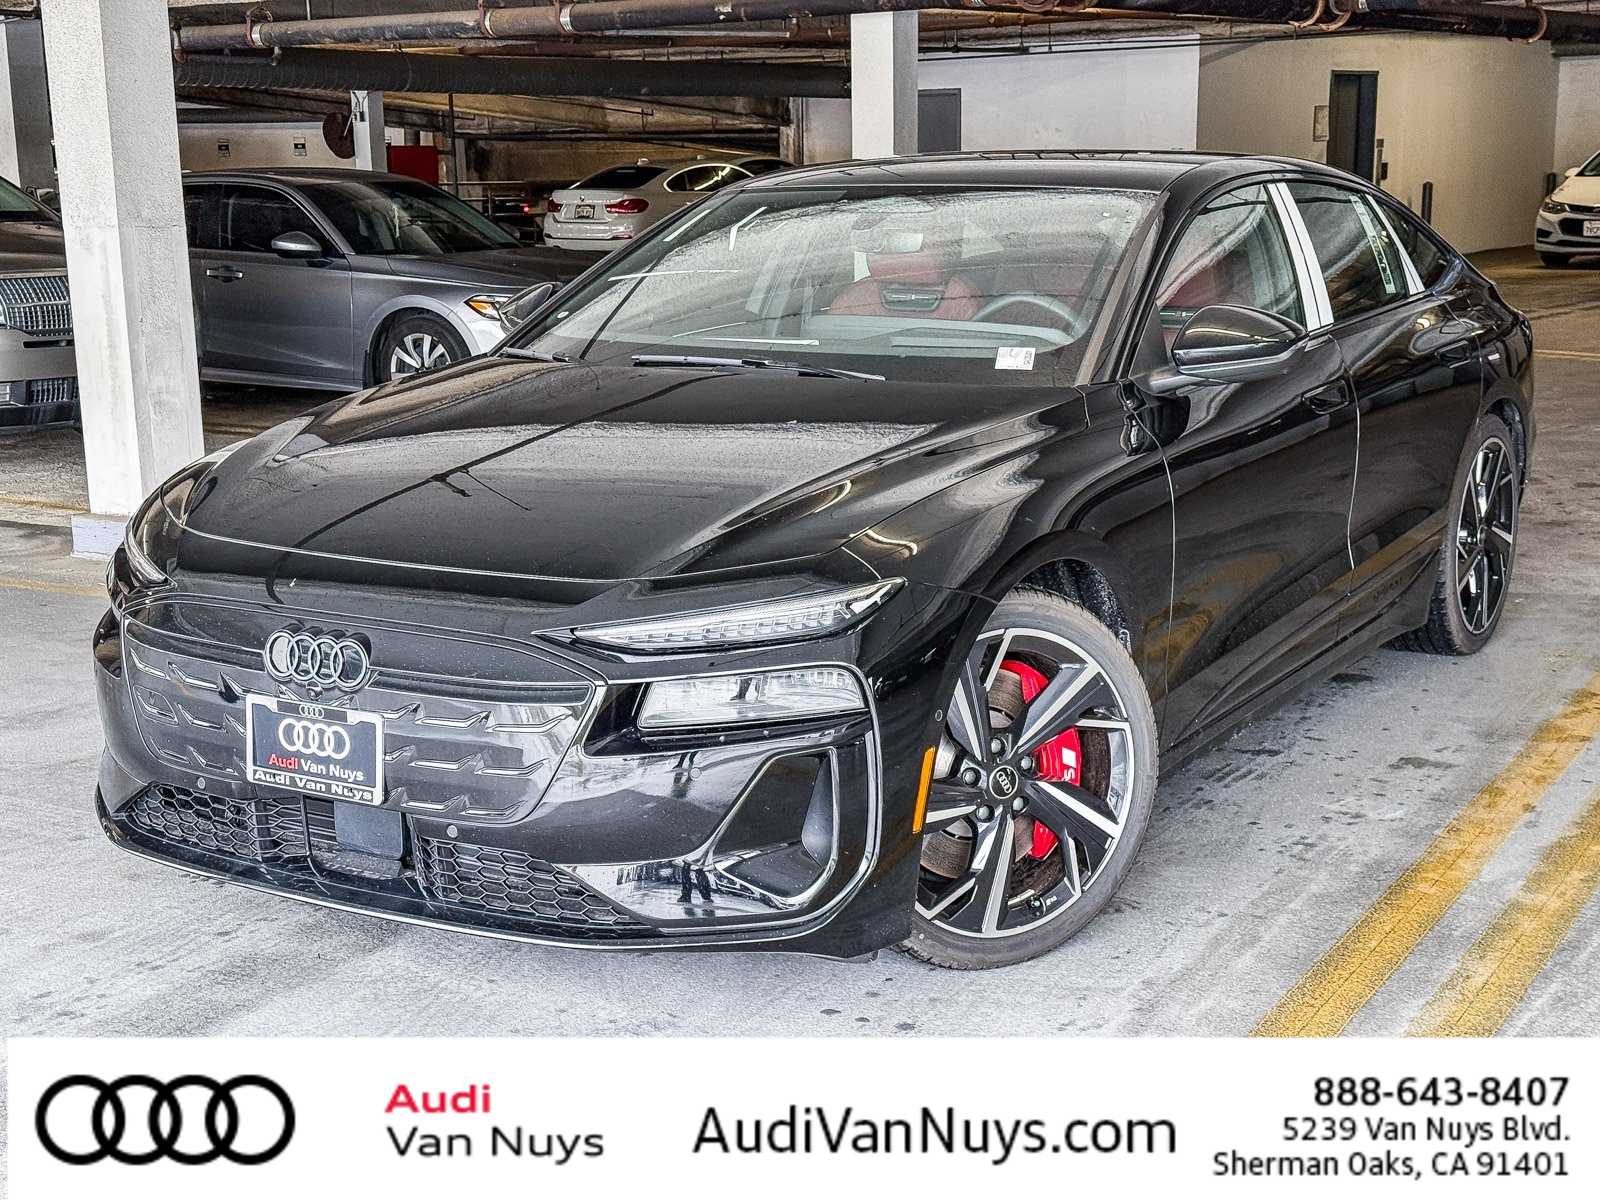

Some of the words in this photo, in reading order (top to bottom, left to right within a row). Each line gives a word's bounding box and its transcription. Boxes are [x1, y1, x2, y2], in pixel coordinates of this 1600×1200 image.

[268, 753, 299, 769] Audi
[300, 759, 327, 774] Van
[329, 765, 364, 782] Nuys
[254, 770, 290, 785] Audi
[295, 778, 326, 792] Van
[331, 784, 373, 800] Nuys
